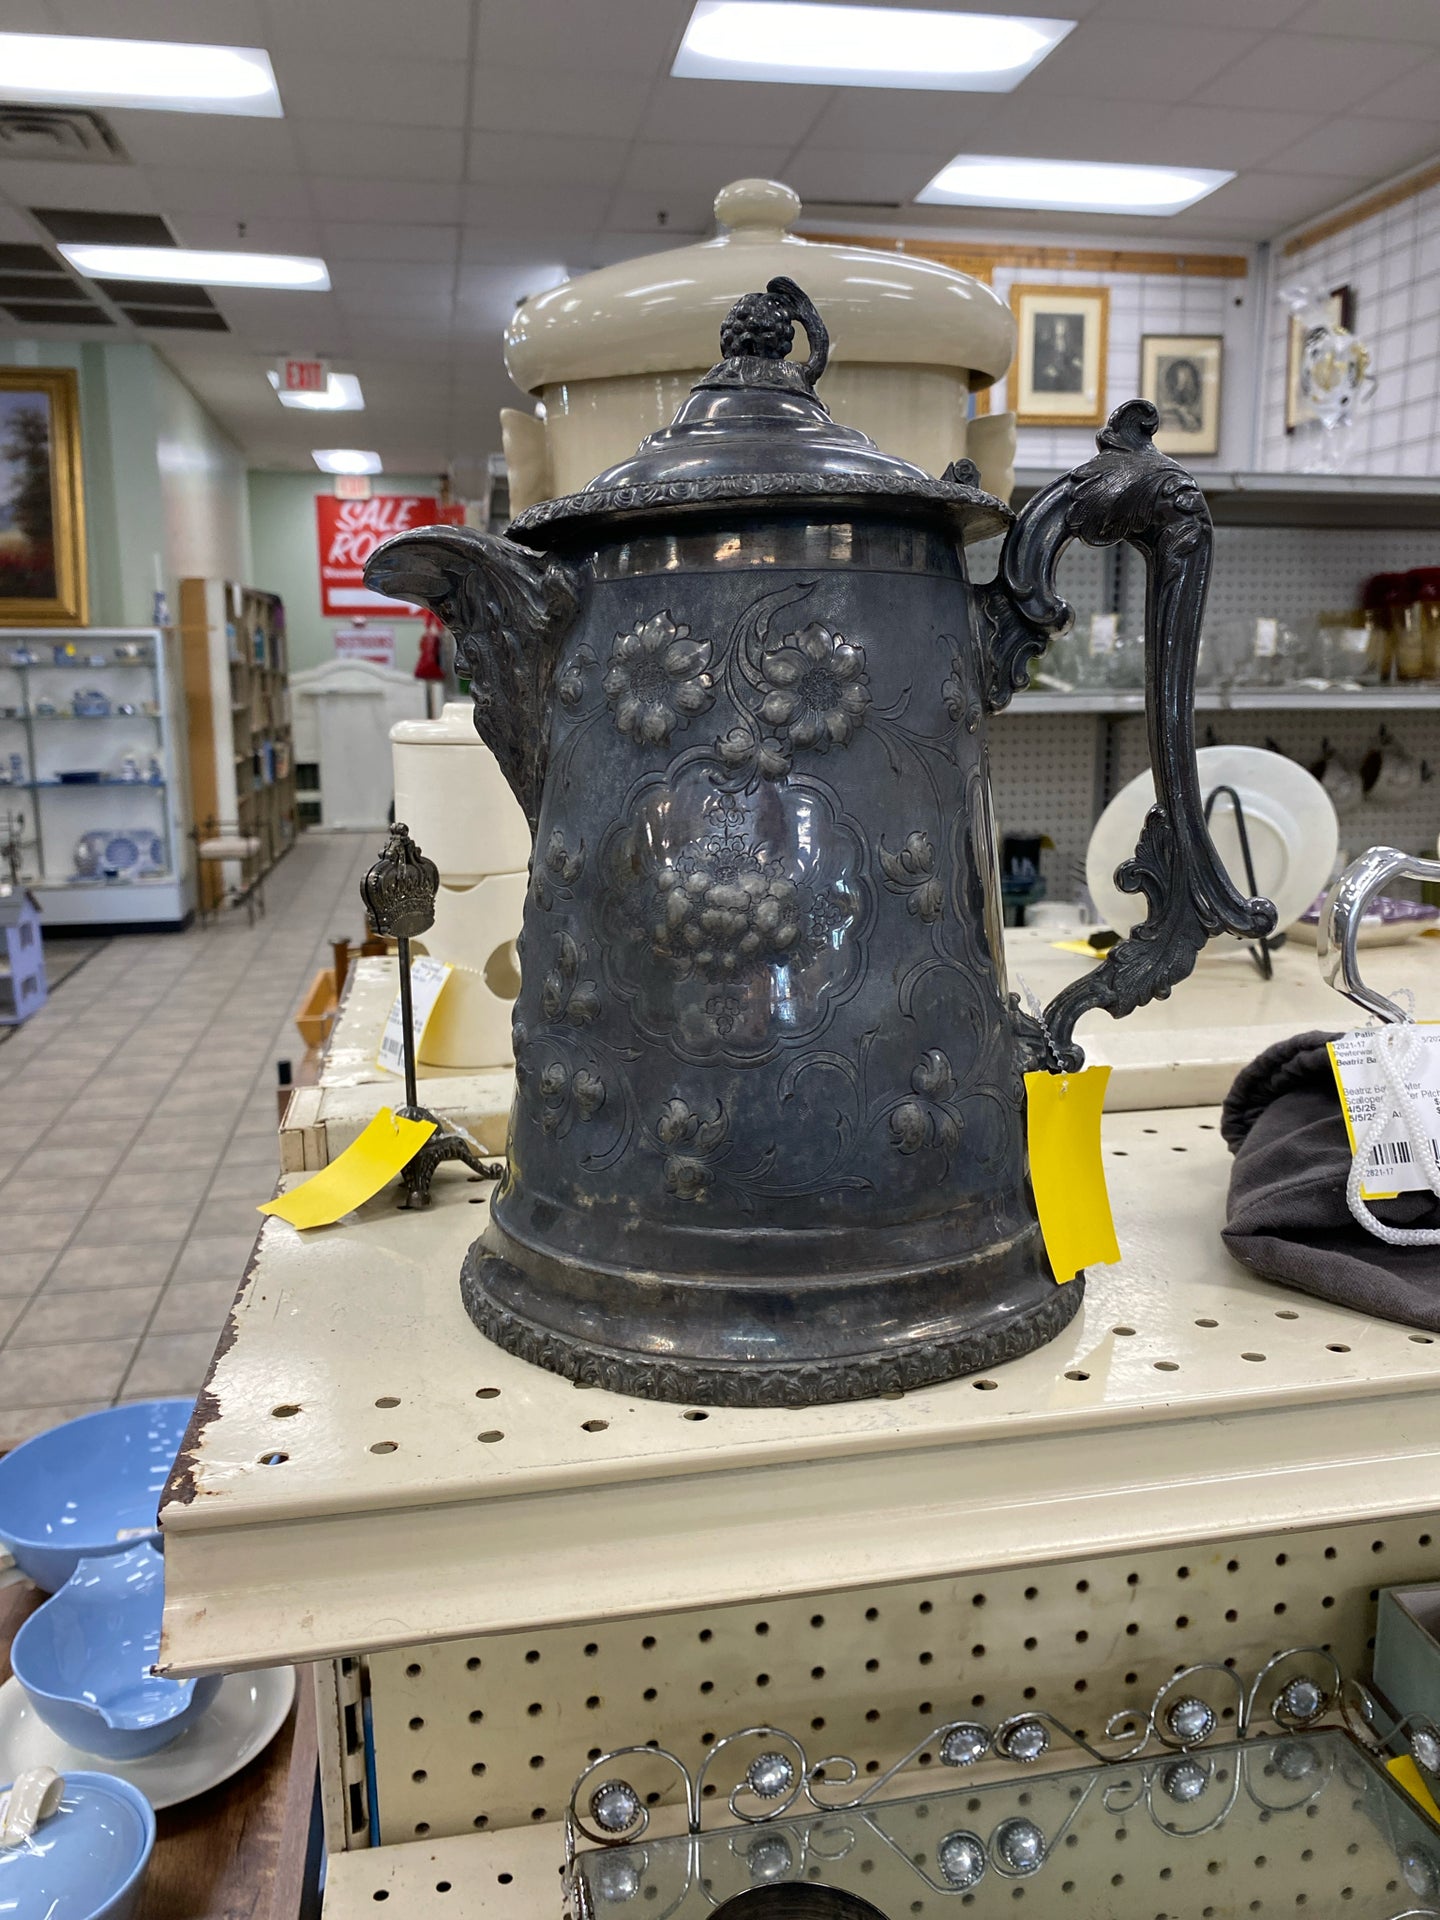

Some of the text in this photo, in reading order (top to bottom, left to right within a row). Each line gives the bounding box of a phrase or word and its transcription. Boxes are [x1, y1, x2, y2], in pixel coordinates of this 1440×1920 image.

[286, 360, 321, 389] EXIT
[334, 498, 420, 533] SALE
[1336, 1057, 1364, 1067] Beatriz
[1347, 1103, 1377, 1113] 4/5/26
